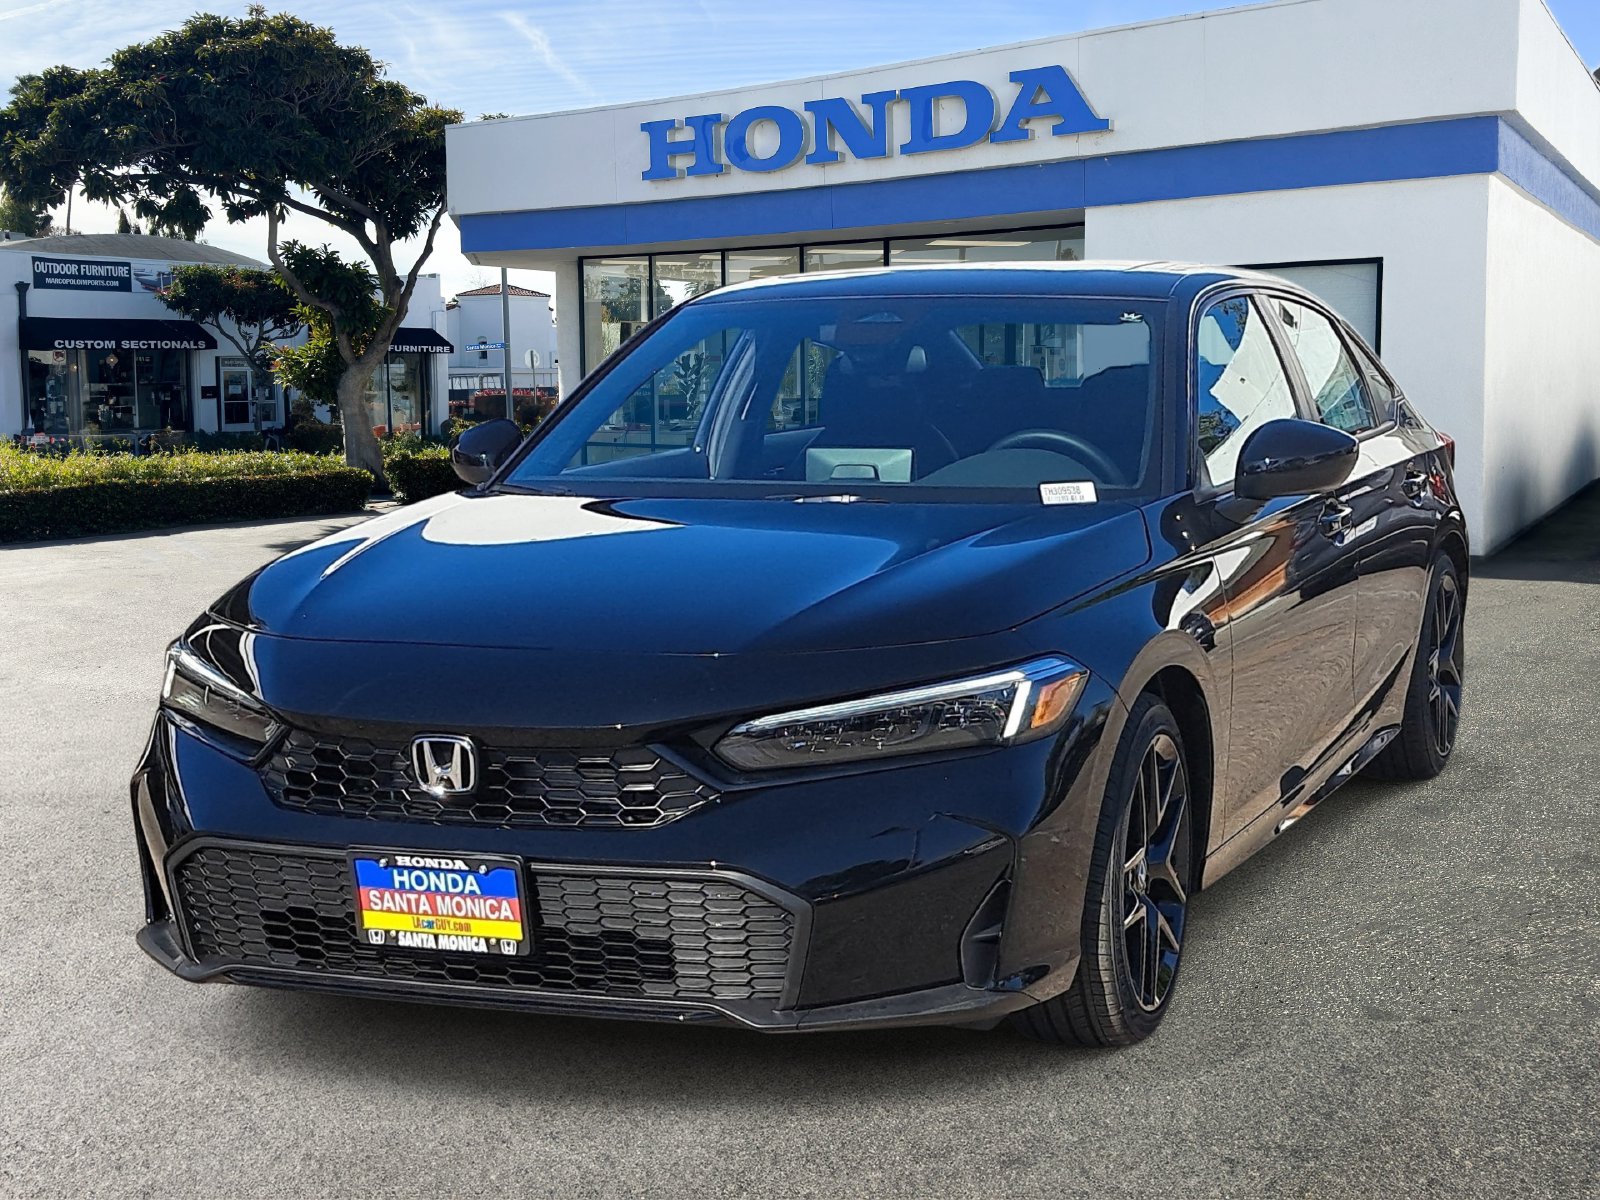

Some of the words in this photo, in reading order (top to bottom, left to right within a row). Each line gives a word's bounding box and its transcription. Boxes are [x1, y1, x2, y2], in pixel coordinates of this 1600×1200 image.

[641, 64, 1112, 182] HONDA
[34, 261, 79, 275] OUTDOOR
[80, 264, 130, 278] FURNITURE
[45, 277, 119, 287] MARCOPOLOIMPORTS.COM
[54, 339, 116, 349] CUSTOM
[121, 340, 206, 349] SECTIONALS
[388, 344, 451, 353] FURNITURE
[395, 855, 470, 871] HONDA
[393, 869, 481, 895] HONDA
[369, 890, 432, 915] SANTA
[437, 895, 515, 921] MONICA
[398, 931, 437, 948] SANTA
[438, 934, 489, 953] MONICA
